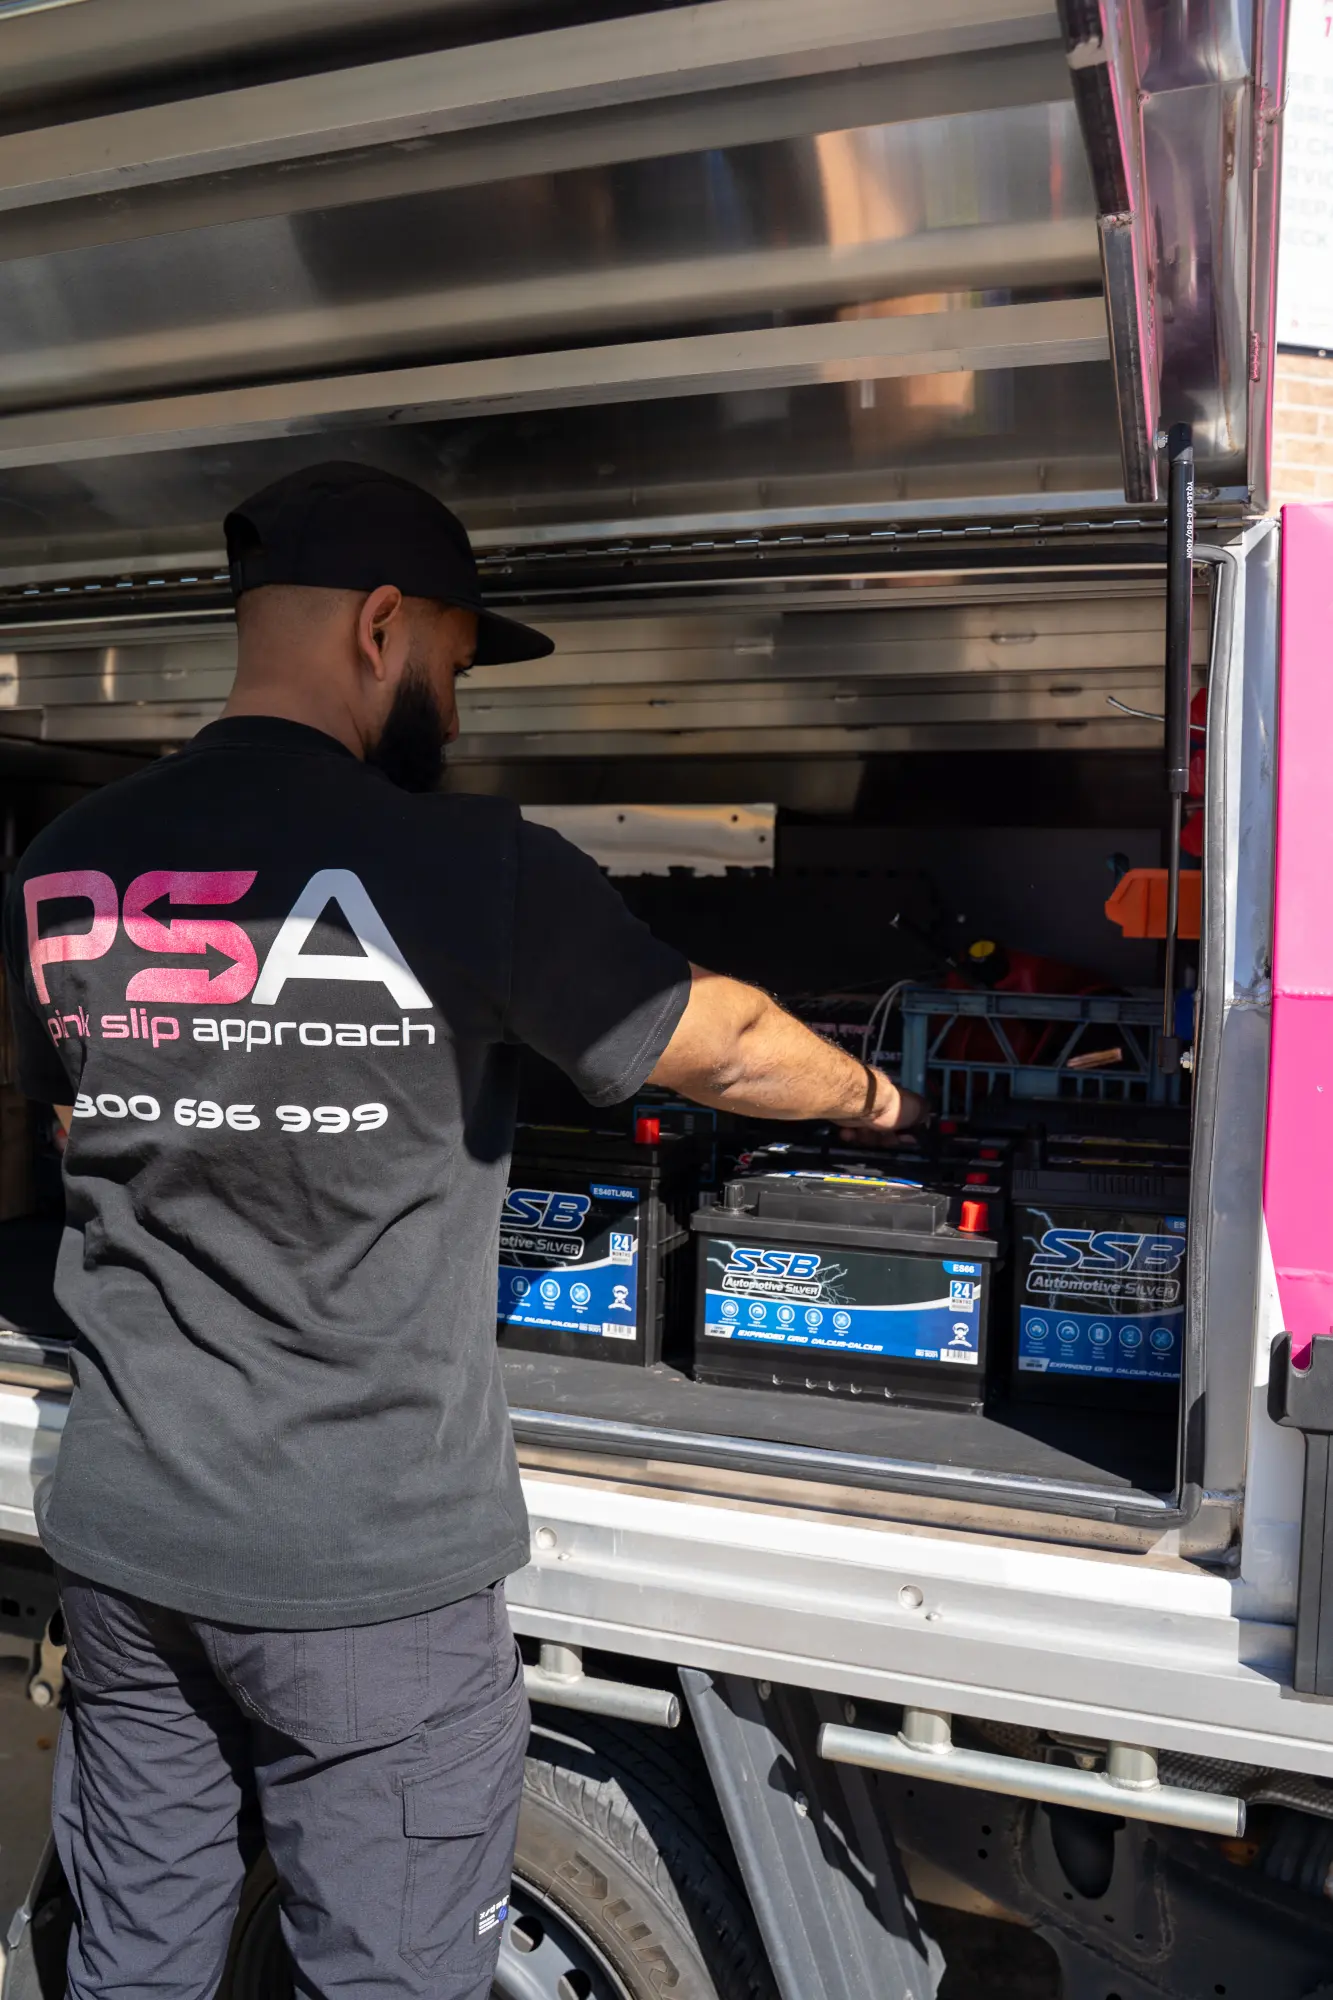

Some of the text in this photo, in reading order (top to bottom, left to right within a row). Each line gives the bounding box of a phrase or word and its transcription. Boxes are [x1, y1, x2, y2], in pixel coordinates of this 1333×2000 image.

[23, 868, 434, 1009] PSA
[47, 1005, 436, 1053] pink slip approach
[174, 1098, 261, 1131] 696
[276, 1102, 389, 1133] 999
[500, 1187, 591, 1232] SB
[500, 1236, 534, 1250] otive
[613, 1234, 630, 1250] 24
[1030, 1228, 1186, 1274] SSB
[725, 1247, 821, 1279] SSB
[952, 1263, 975, 1274] ES66
[725, 1277, 819, 1296] Automotive SILVER
[953, 1282, 971, 1299] 24
[1032, 1275, 1175, 1298] Automotive SILVER
[738, 1329, 786, 1341] EXPANDED
[787, 1334, 808, 1343] GRID
